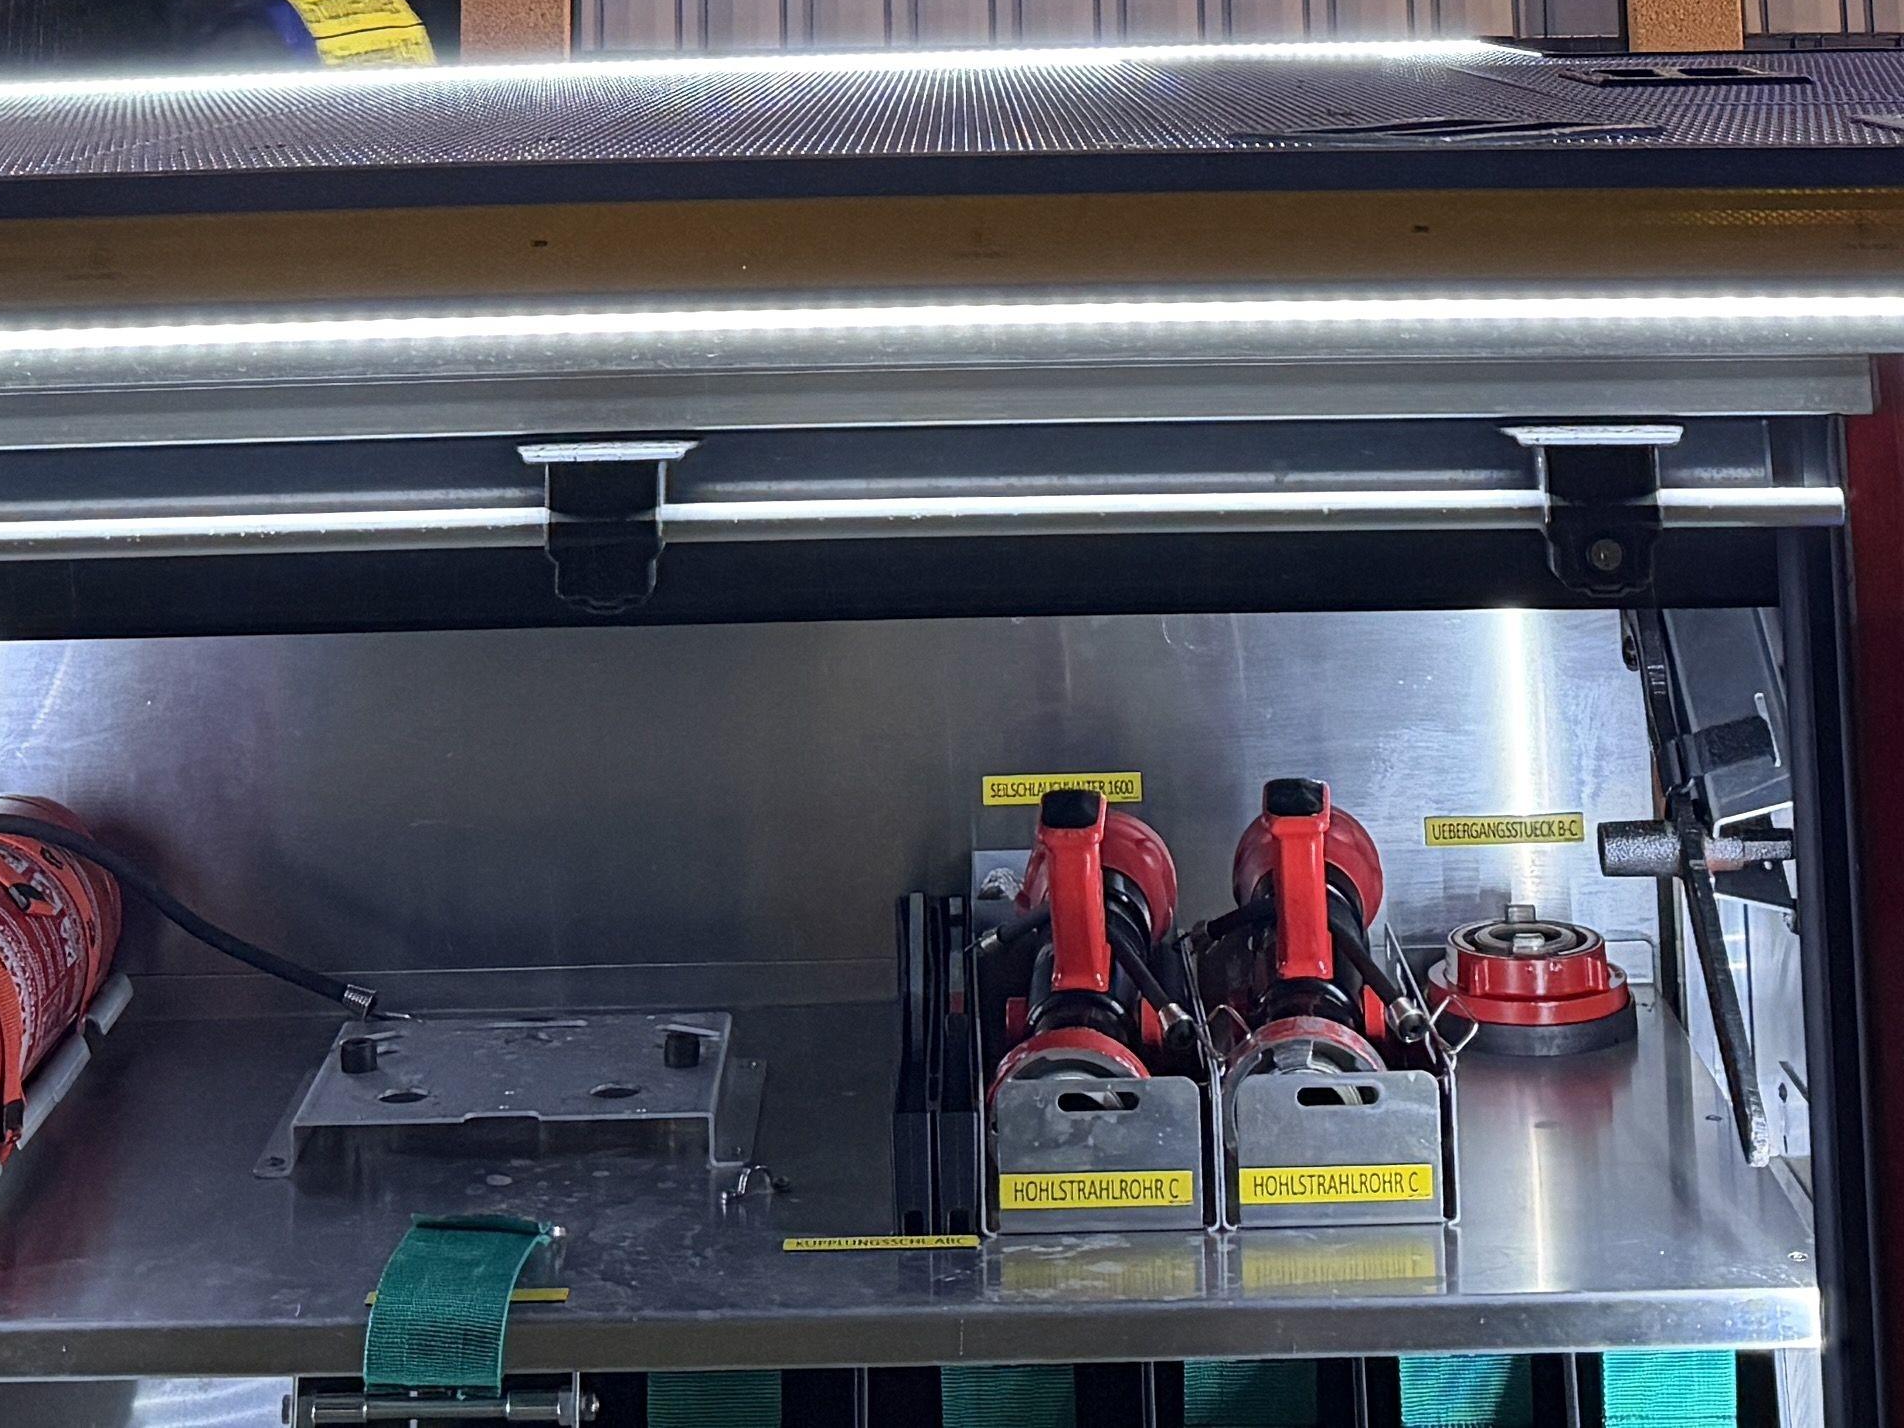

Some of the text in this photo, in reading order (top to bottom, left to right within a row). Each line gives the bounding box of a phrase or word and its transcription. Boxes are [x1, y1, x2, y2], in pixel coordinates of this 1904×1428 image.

[1108, 779, 1134, 795] 1600
[1431, 819, 1578, 840] UEBERGANGSSTUECK B-C
[1014, 1178, 1180, 1201] HOHLSTRAHLROHR C
[1253, 1171, 1419, 1196] HOHLSTRAHLROHR C
